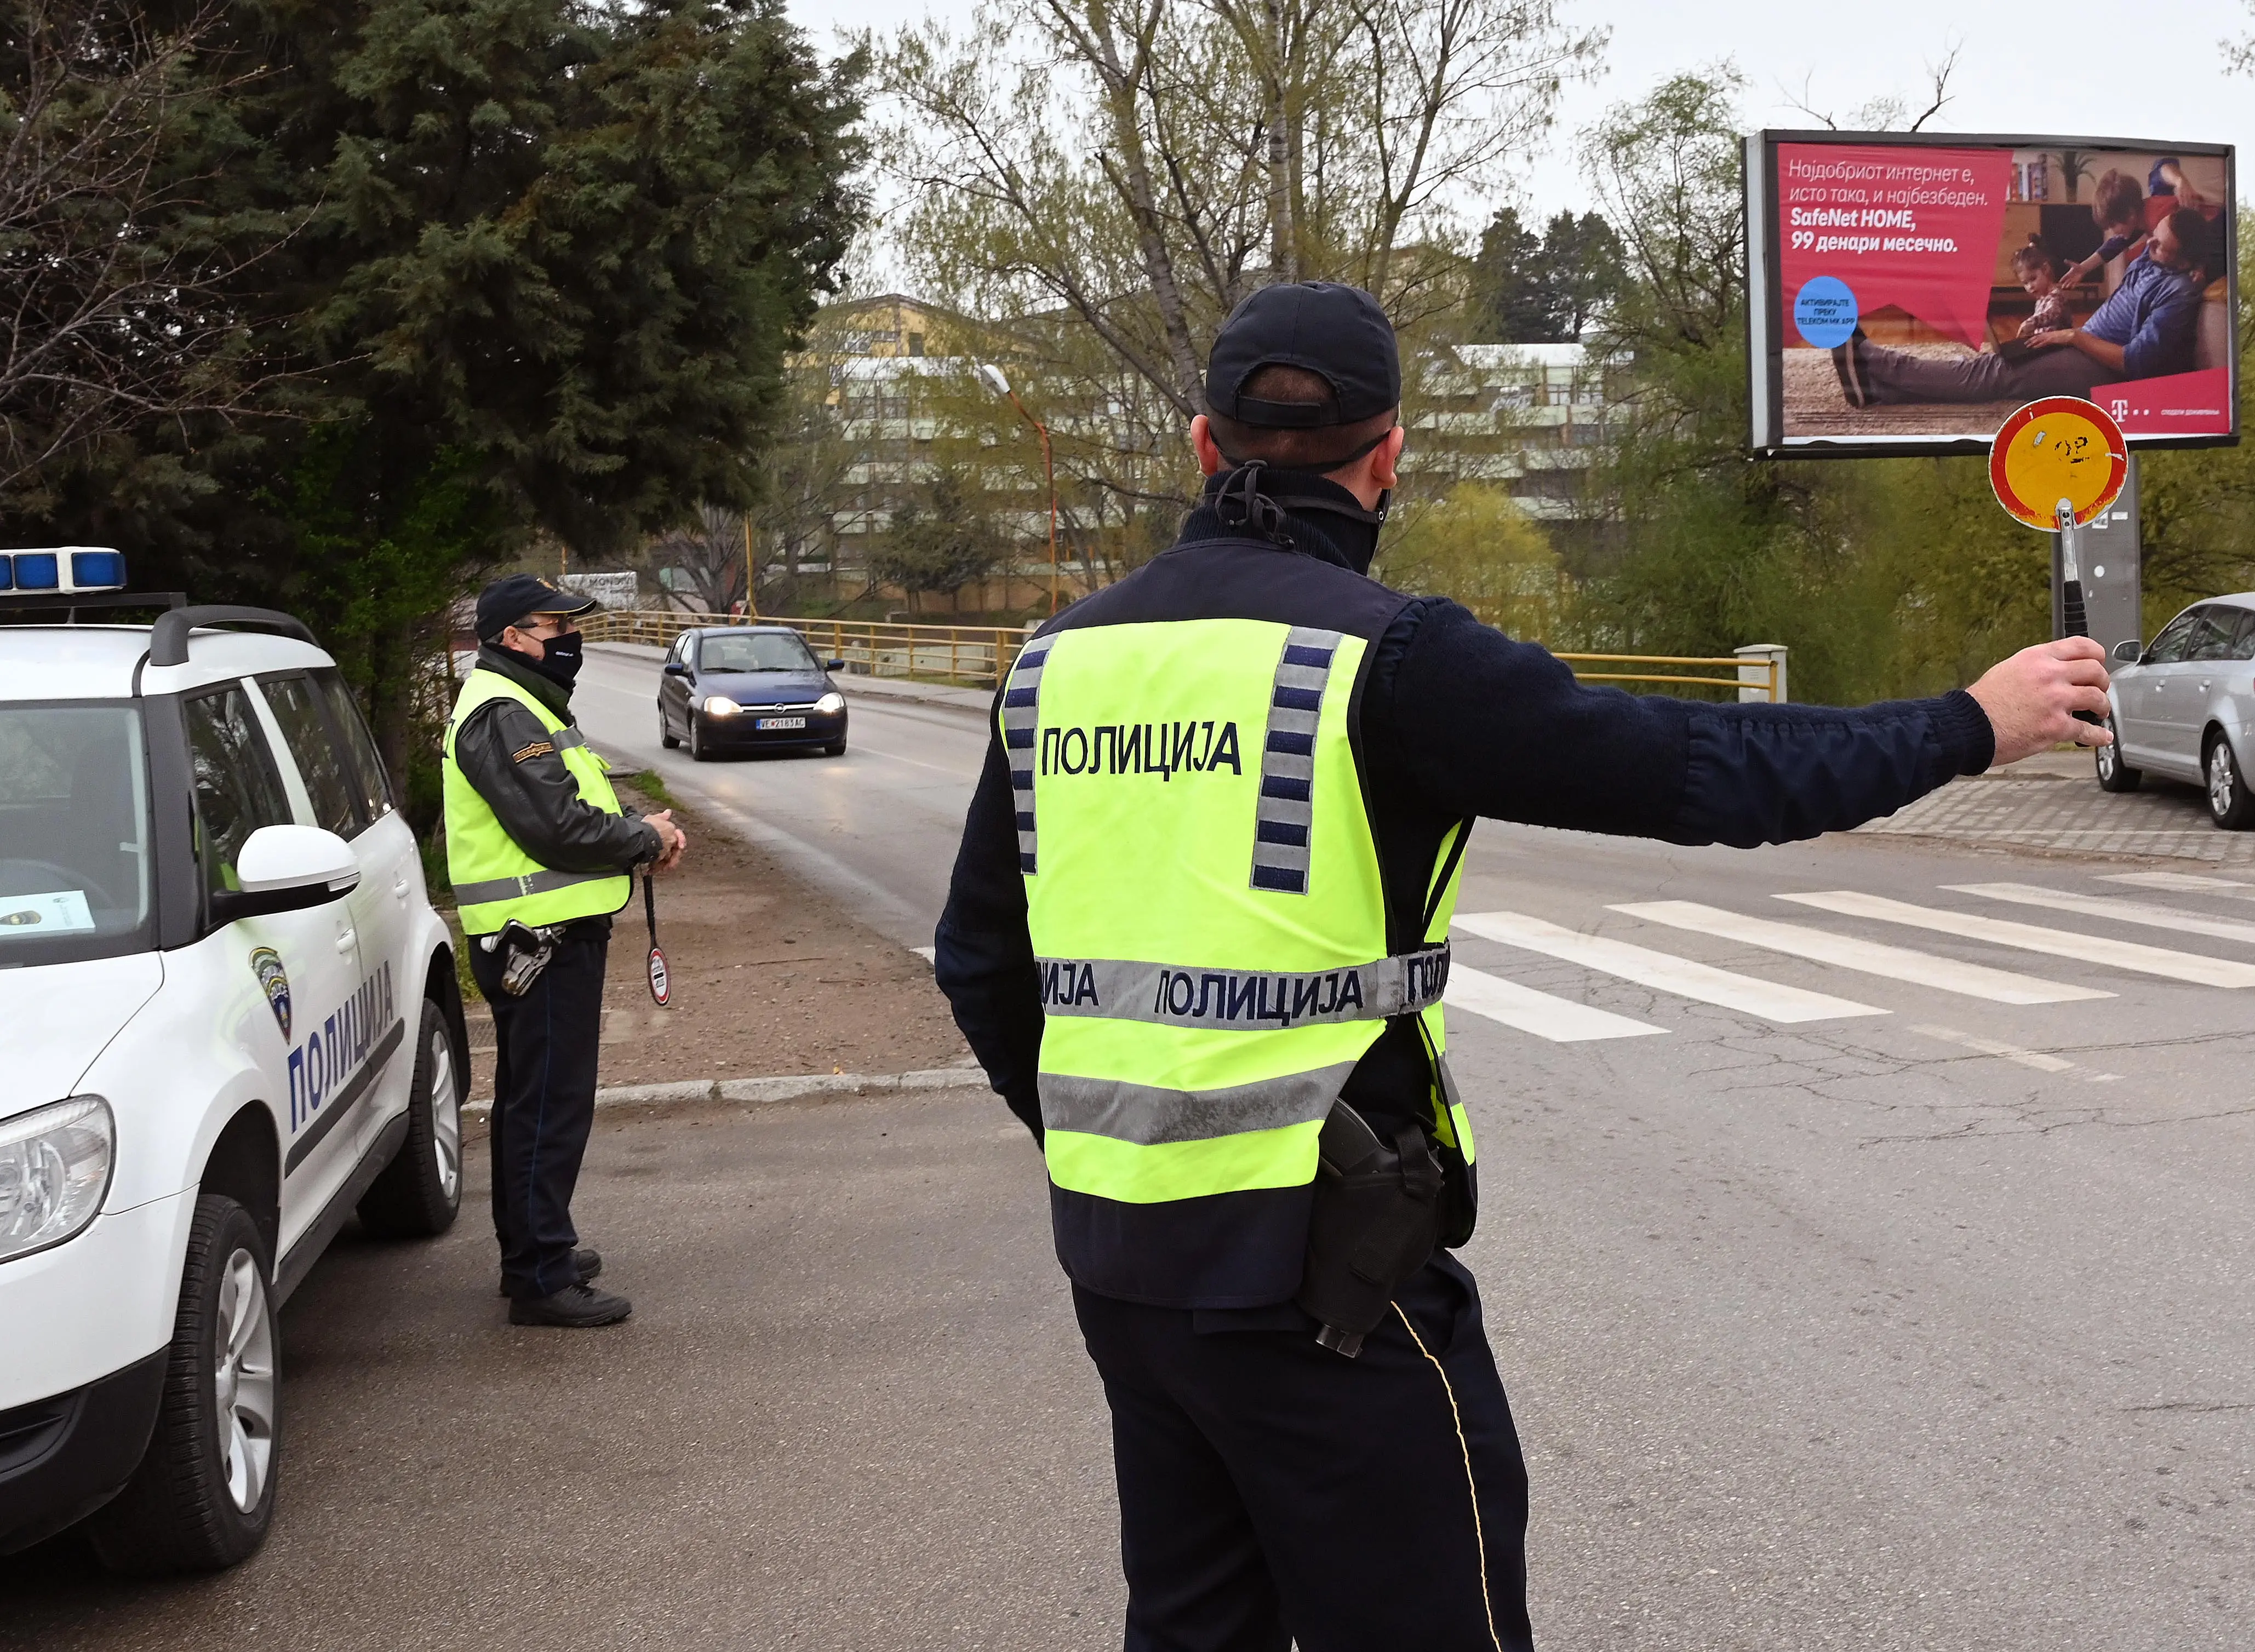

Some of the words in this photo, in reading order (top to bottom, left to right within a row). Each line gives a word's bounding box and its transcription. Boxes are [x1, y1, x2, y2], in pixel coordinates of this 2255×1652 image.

[1789, 158, 1885, 182] Најдобриот
[1885, 165, 1959, 184] интернет
[1962, 169, 1974, 185] е,
[1789, 187, 1827, 202] исто
[1830, 188, 1869, 206] така,
[1873, 189, 1884, 203] и
[1887, 186, 1989, 208] најбезбеден.
[1790, 206, 1858, 227] SafeNet
[1861, 209, 1916, 232] HOME,
[1790, 231, 1815, 250] 99
[1815, 235, 1880, 254] денари
[1882, 237, 1959, 253] месечно.
[1042, 721, 1242, 782] ПОЛИЦИЈА
[1041, 962, 1100, 1008] ИЈА
[1154, 970, 1364, 1026] ПОЛИЦИЈА
[288, 960, 394, 1134] ПОЛИЦИЈА
